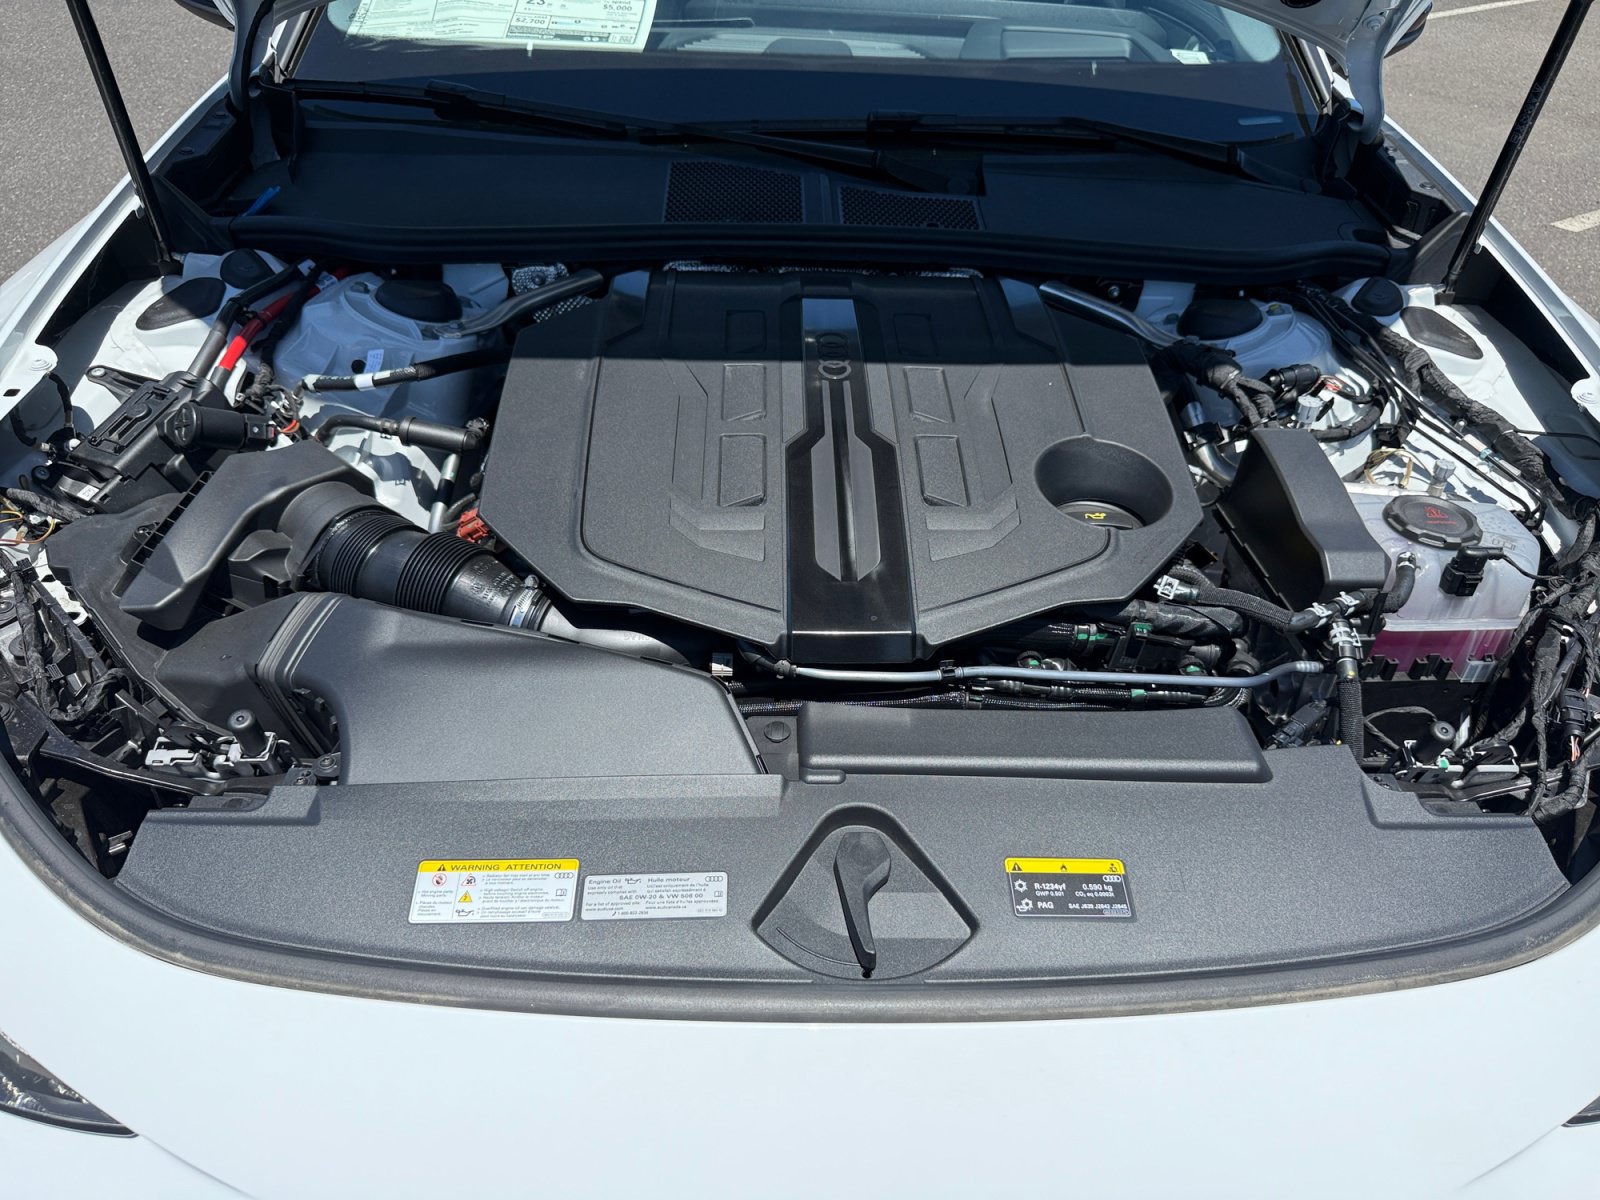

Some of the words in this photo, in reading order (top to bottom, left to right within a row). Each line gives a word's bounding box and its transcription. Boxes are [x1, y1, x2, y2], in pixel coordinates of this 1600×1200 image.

[515, 17, 545, 25] $2,700
[1034, 882, 1066, 891] R-1234yf
[1103, 883, 1113, 892] kg
[1037, 901, 1054, 909] PAG
